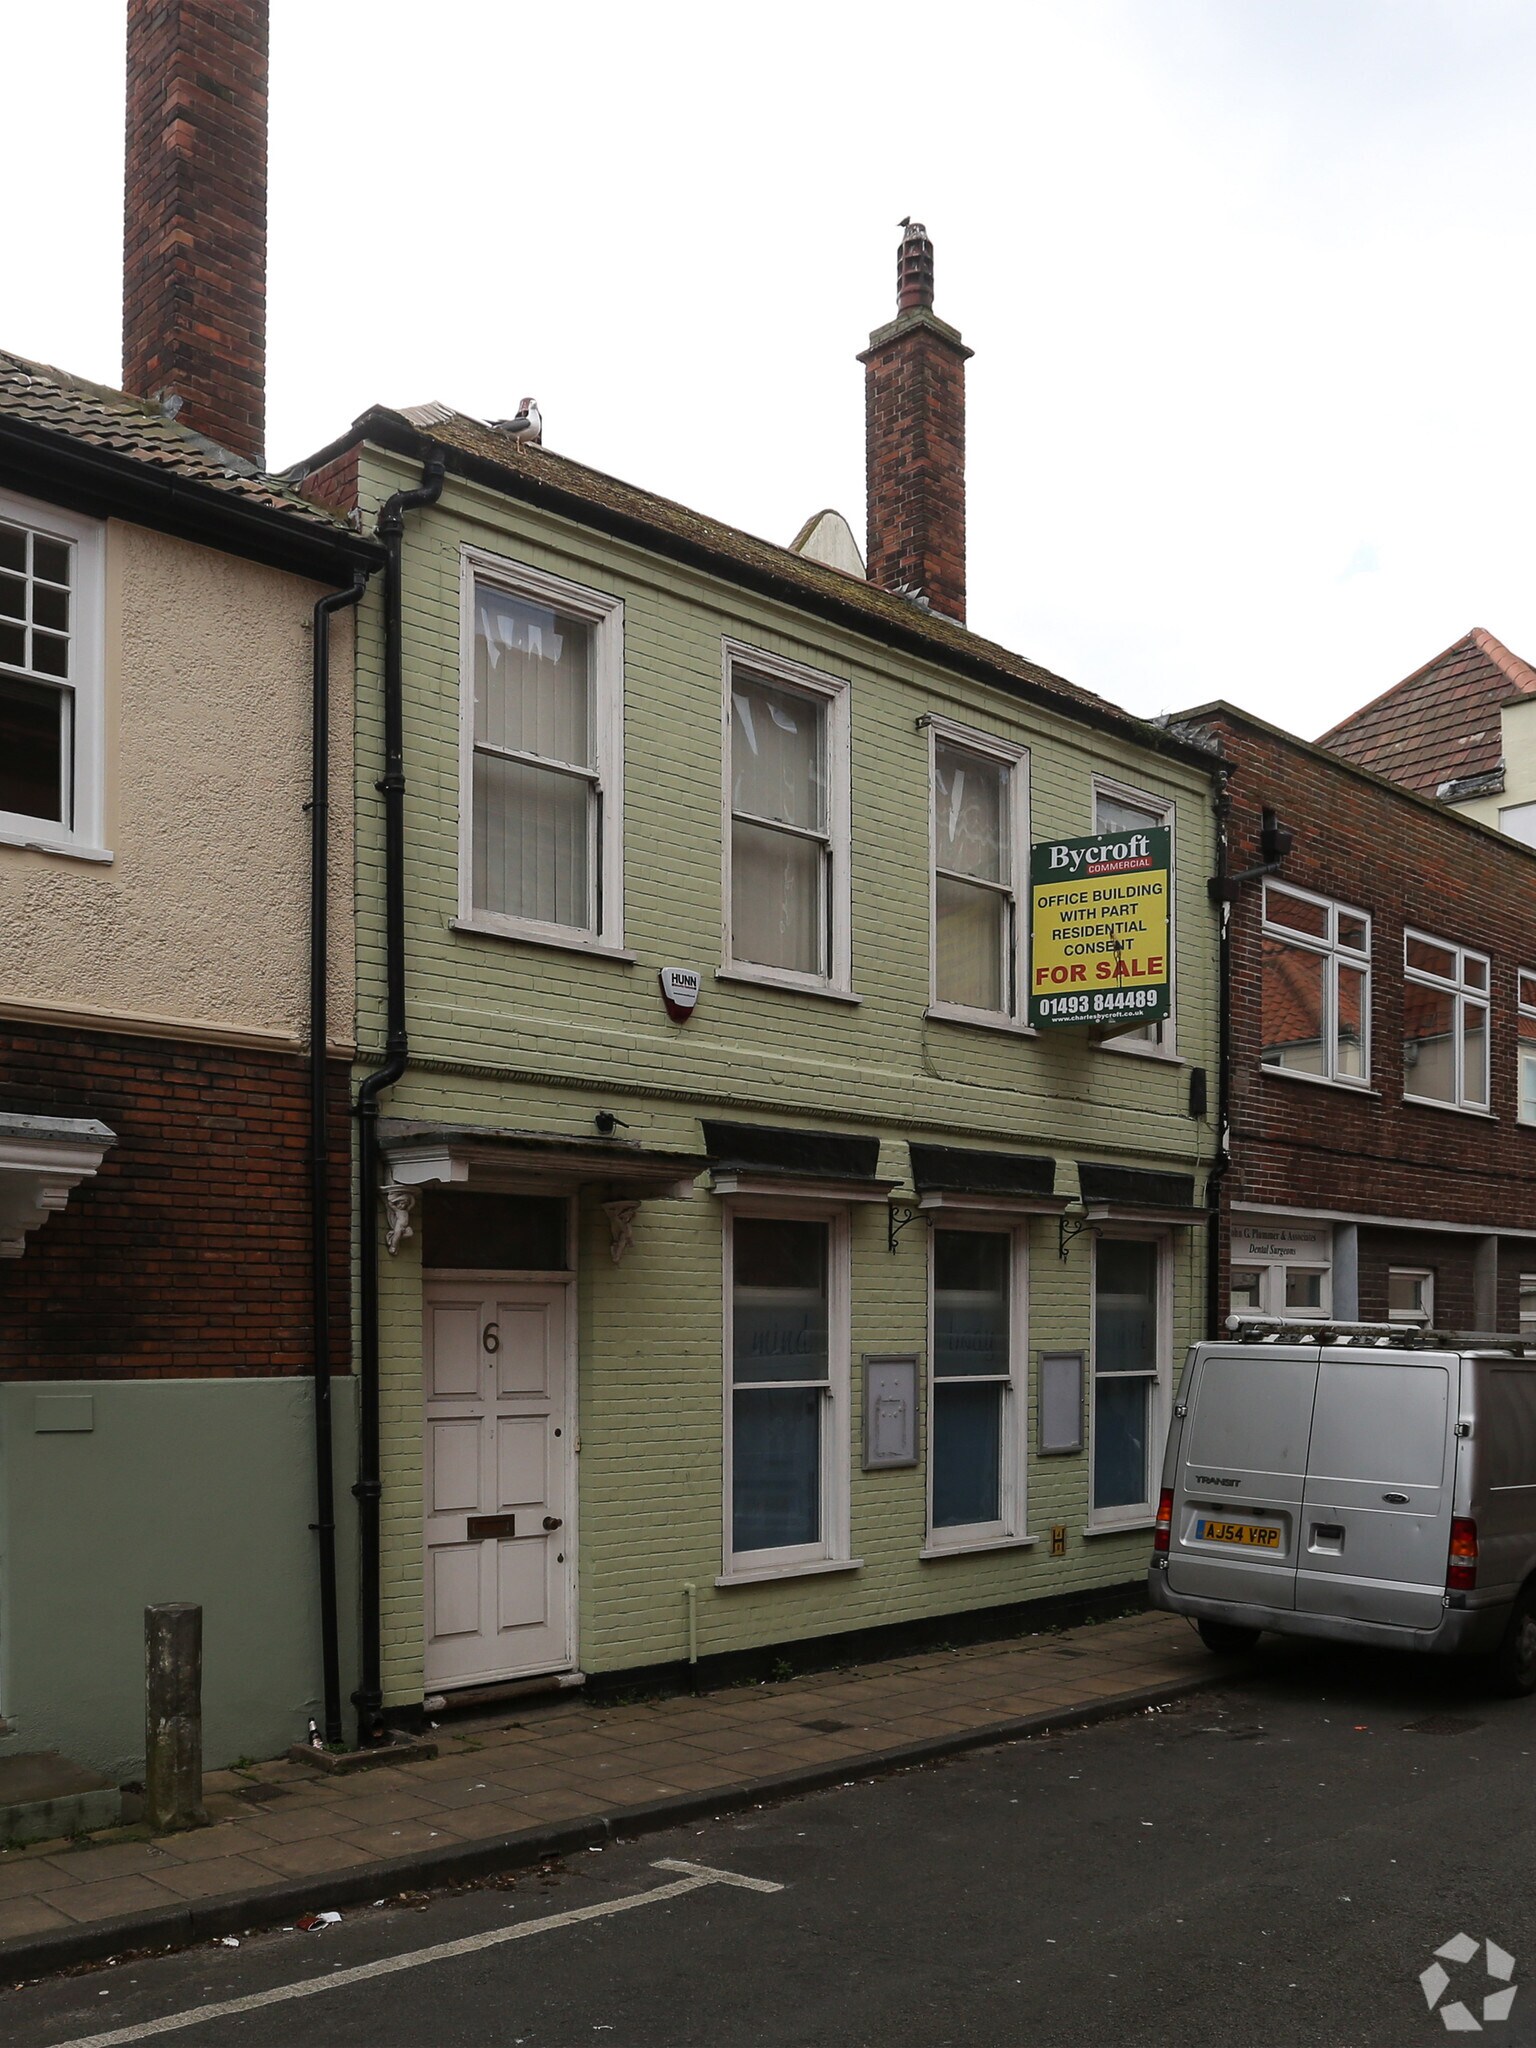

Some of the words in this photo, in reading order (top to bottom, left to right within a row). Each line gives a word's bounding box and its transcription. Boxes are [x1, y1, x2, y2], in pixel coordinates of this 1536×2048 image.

[1048, 834, 1150, 872] Bycroft
[1088, 859, 1150, 873] COMMERCIAL
[1038, 892, 1088, 908] OFFICE
[1093, 883, 1163, 902] BUILDING
[1060, 908, 1097, 922] WITH
[1101, 903, 1139, 918] PART
[1052, 920, 1147, 940] RESIDENTIAL
[1064, 938, 1135, 956] CONSENT
[671, 973, 697, 987] HUNN
[1036, 964, 1087, 985] FOR
[1095, 956, 1163, 980] SALE
[1040, 995, 1089, 1016] 01493
[1093, 989, 1158, 1011] 844489
[1052, 1010, 1144, 1023] www.charlesbycroft.co.uk
[1280, 1230, 1286, 1241] &
[1287, 1232, 1316, 1241] Associates
[1249, 1243, 1268, 1255] Dental
[1269, 1244, 1296, 1257] Surgeons
[483, 1322, 500, 1354] 6
[1195, 1475, 1241, 1487] TRANSIT
[1052, 1527, 1065, 1554] H
[1206, 1523, 1243, 1541] AJ54
[1249, 1527, 1278, 1545] VRP
